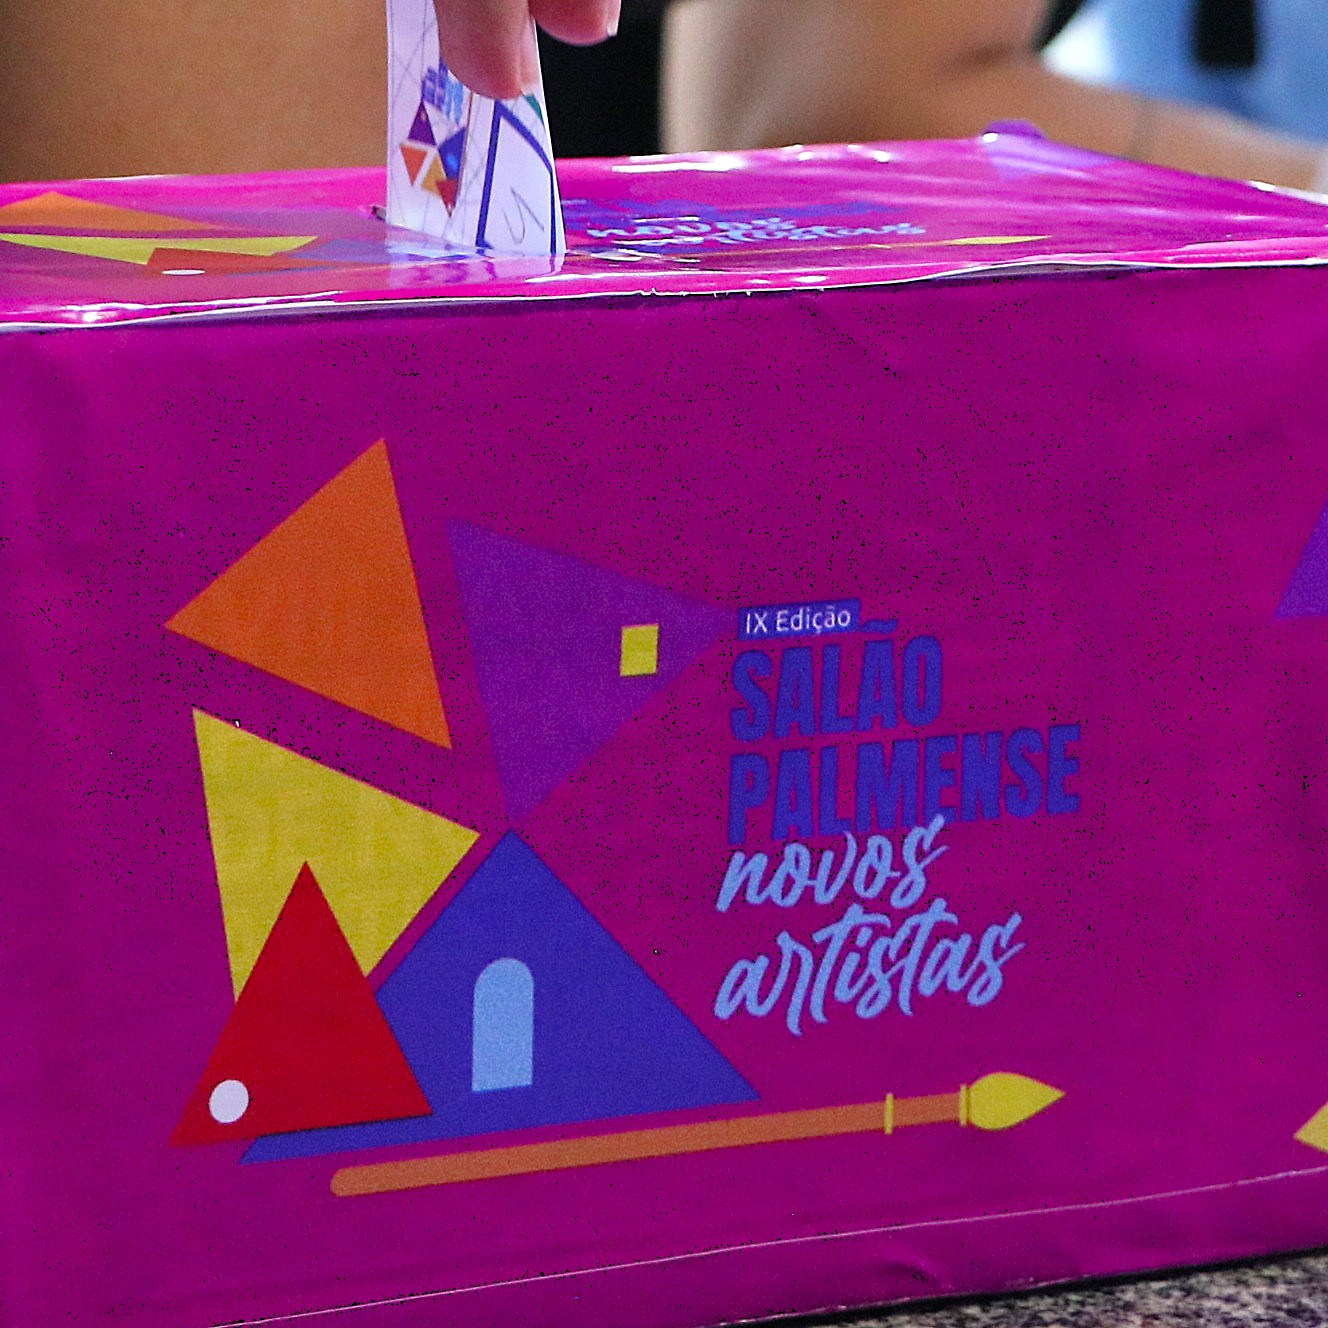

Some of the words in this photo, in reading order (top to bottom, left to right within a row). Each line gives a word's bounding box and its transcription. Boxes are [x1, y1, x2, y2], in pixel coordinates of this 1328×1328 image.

[729, 618, 944, 742] SALÃO
[745, 613, 768, 635] IX
[775, 604, 852, 634] Edição
[727, 723, 1082, 845] PALMENSE
[715, 813, 950, 913] novos
[713, 897, 1027, 1036] artistas
